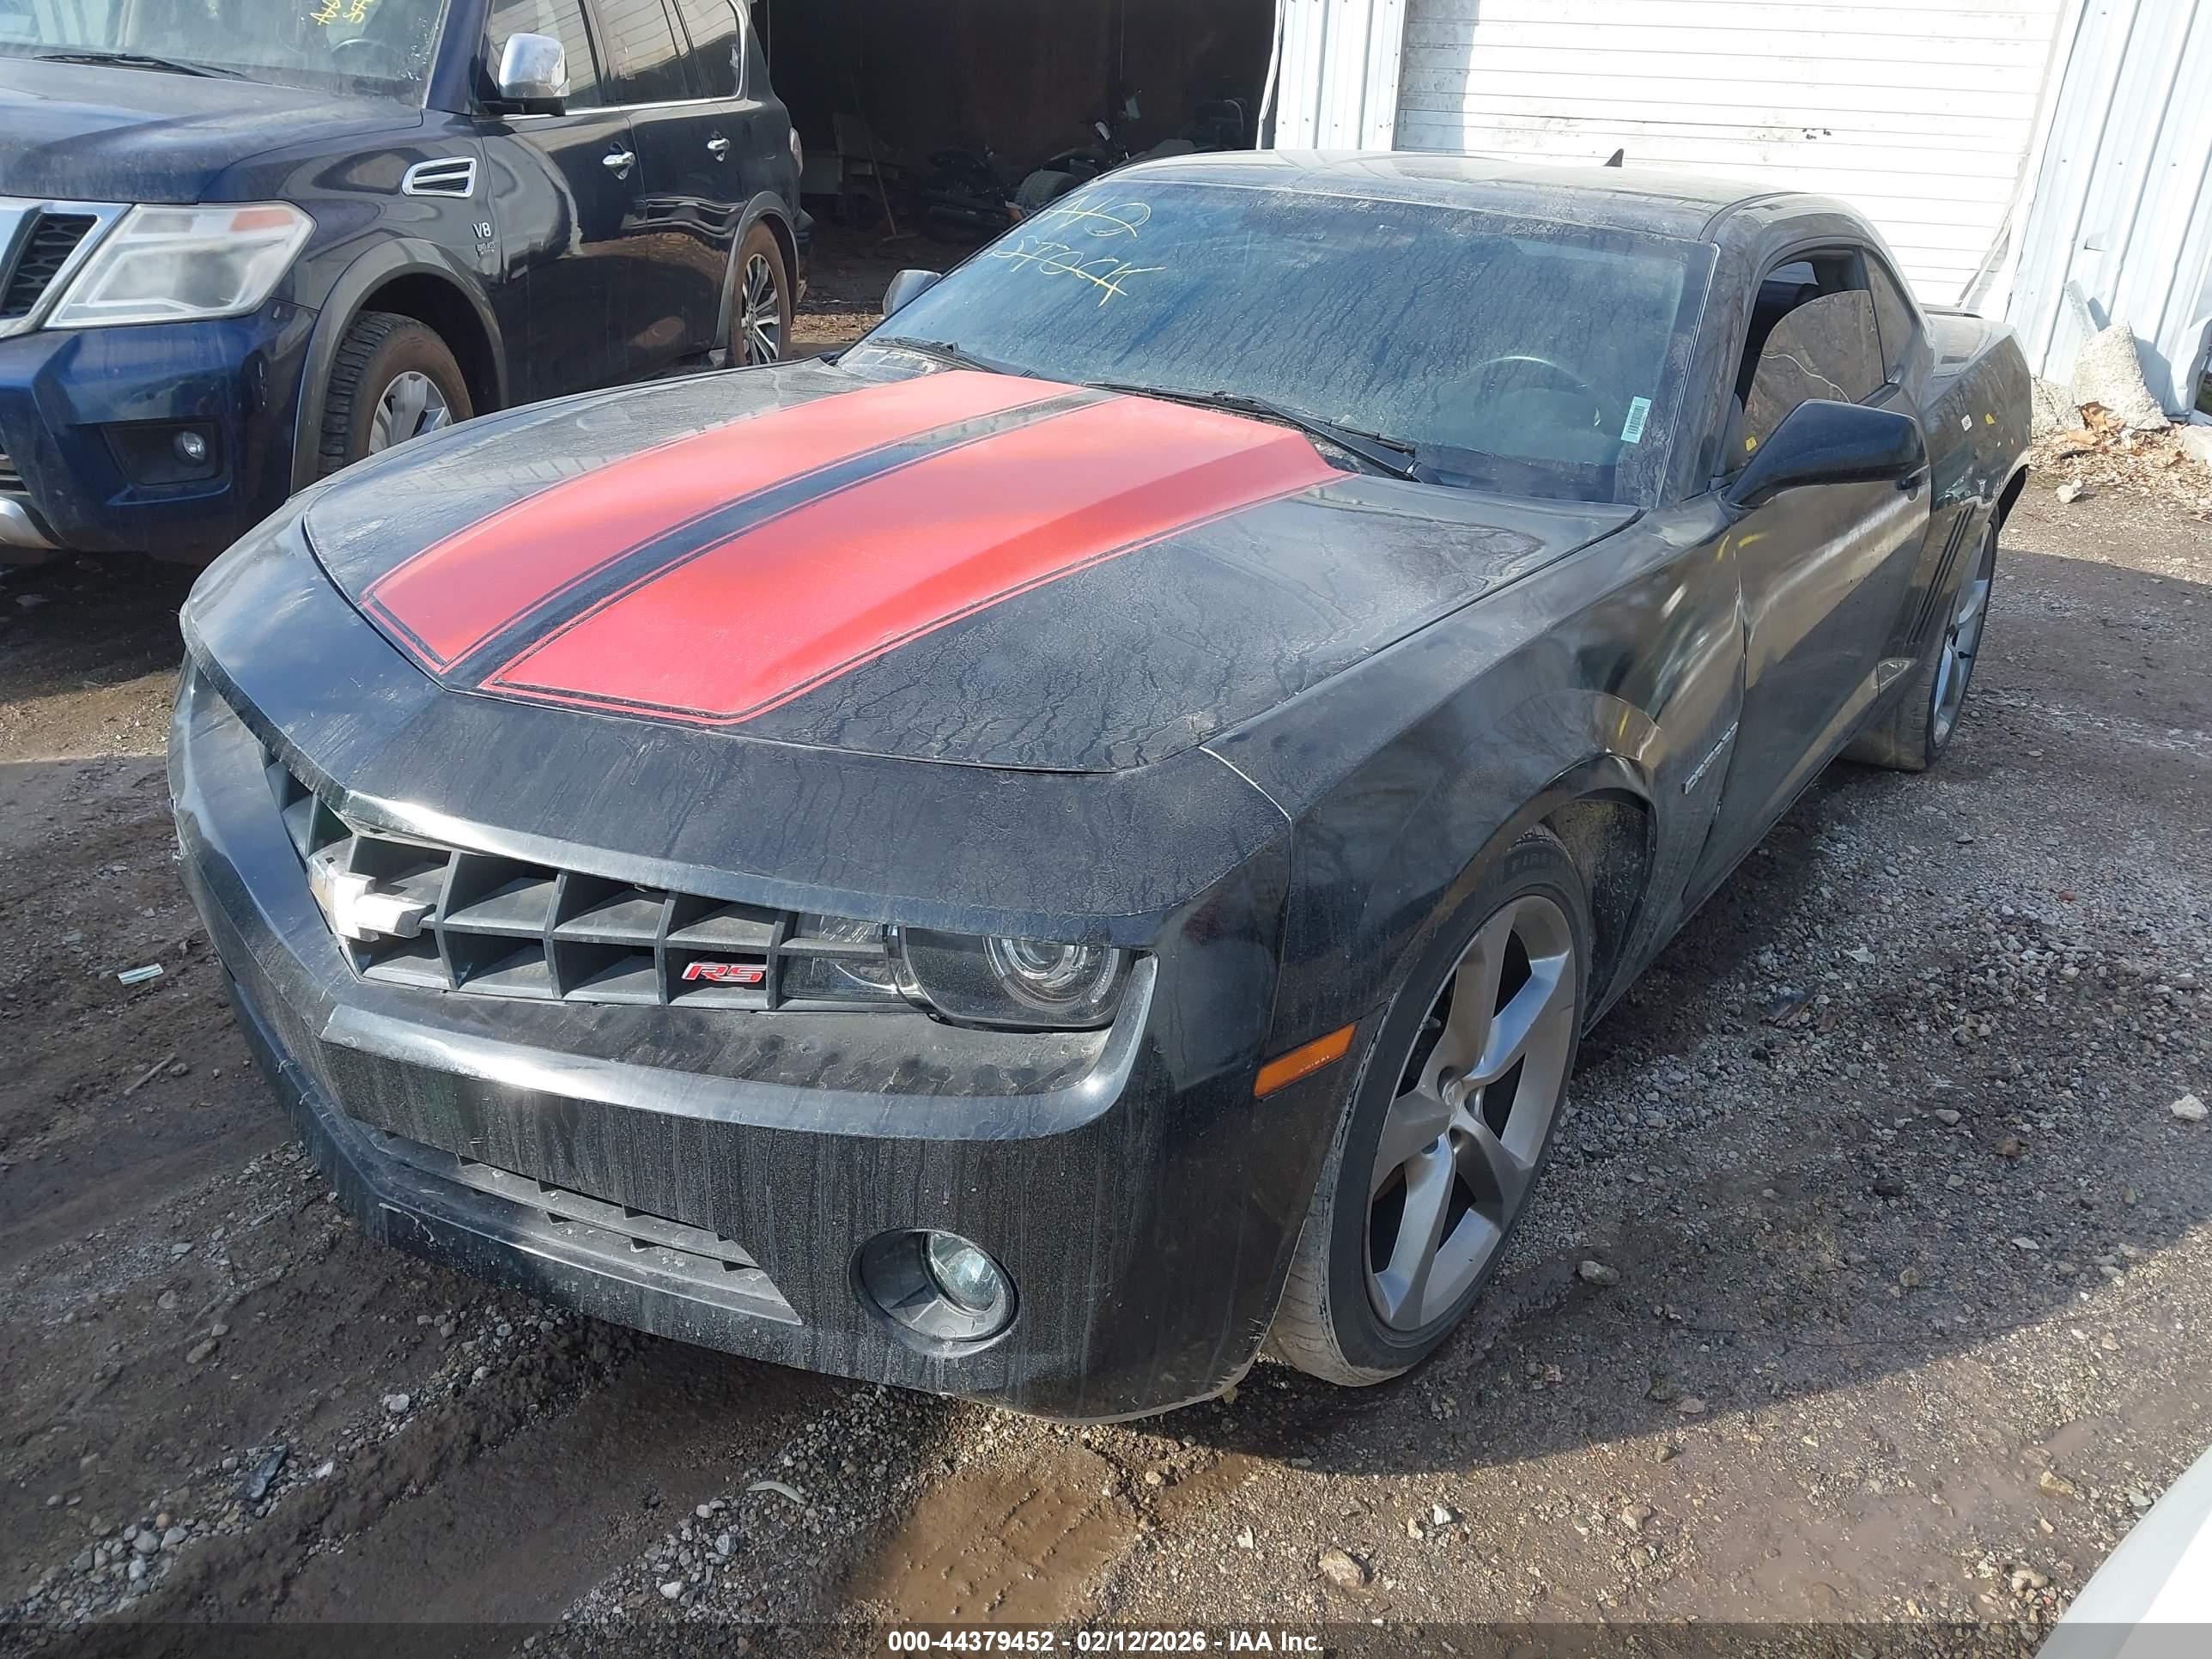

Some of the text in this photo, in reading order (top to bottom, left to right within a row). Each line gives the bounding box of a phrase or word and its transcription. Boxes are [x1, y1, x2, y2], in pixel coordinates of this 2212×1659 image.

[471, 222, 491, 238] V8
[1033, 195, 1152, 238] NO
[992, 235, 1167, 307] STOCK
[681, 962, 768, 983] RS
